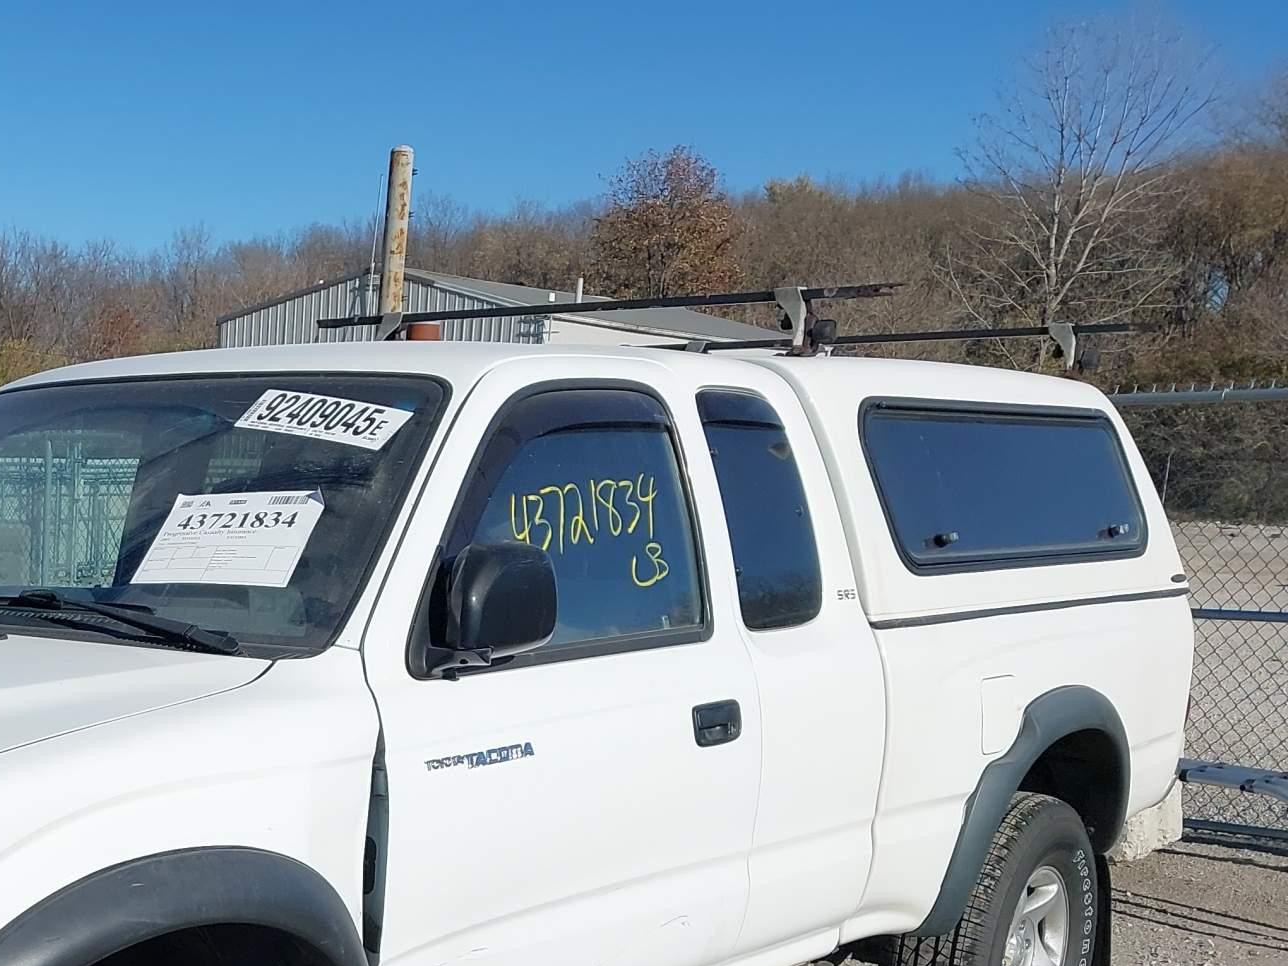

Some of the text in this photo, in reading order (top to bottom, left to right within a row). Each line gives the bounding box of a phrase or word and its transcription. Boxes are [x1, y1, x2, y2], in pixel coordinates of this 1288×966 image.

[177, 512, 298, 530] 43721834
[511, 474, 658, 554] 43721834
[463, 742, 534, 769] TACOMA
